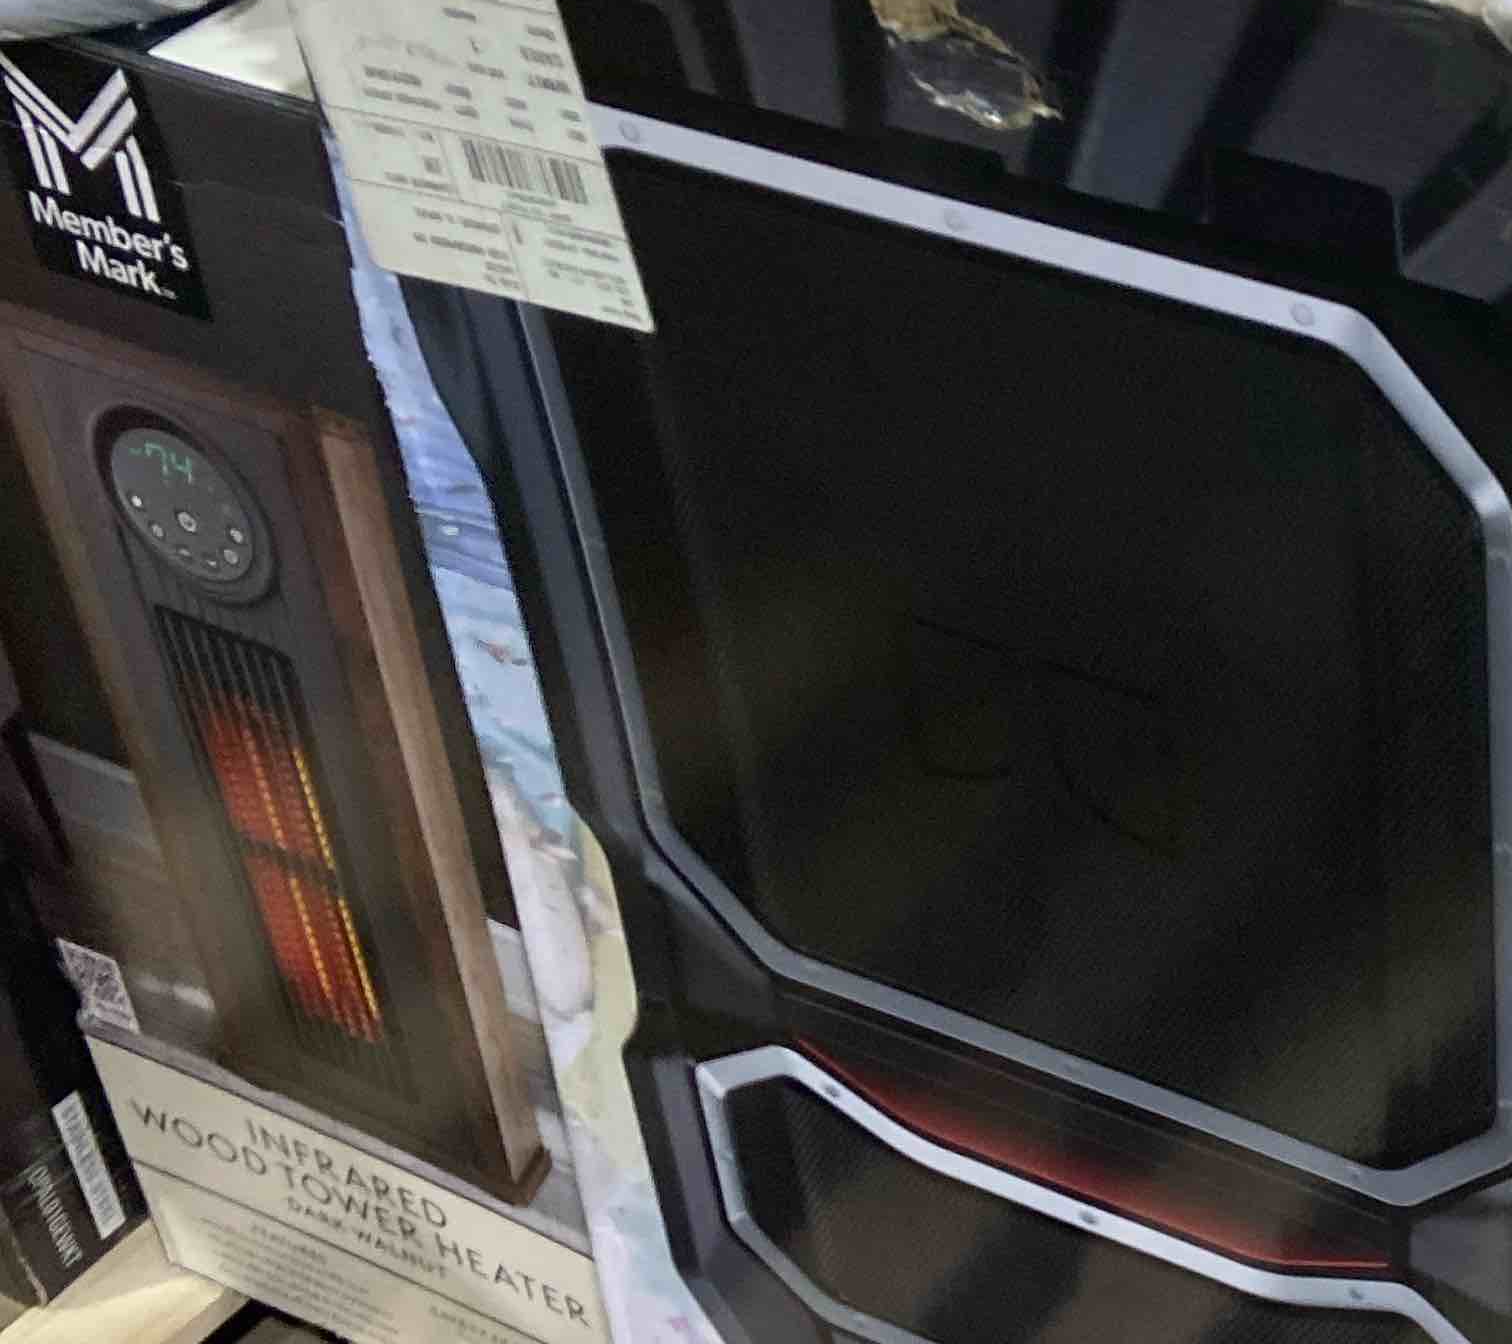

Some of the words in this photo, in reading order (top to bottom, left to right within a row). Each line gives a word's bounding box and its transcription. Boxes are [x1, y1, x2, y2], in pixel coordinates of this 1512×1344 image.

[28, 191, 189, 270] Member's
[129, 1097, 267, 1176] WOOD
[278, 1161, 422, 1248] TOWER
[435, 1231, 593, 1329] HEATER
[245, 1118, 447, 1228] INFRARED
